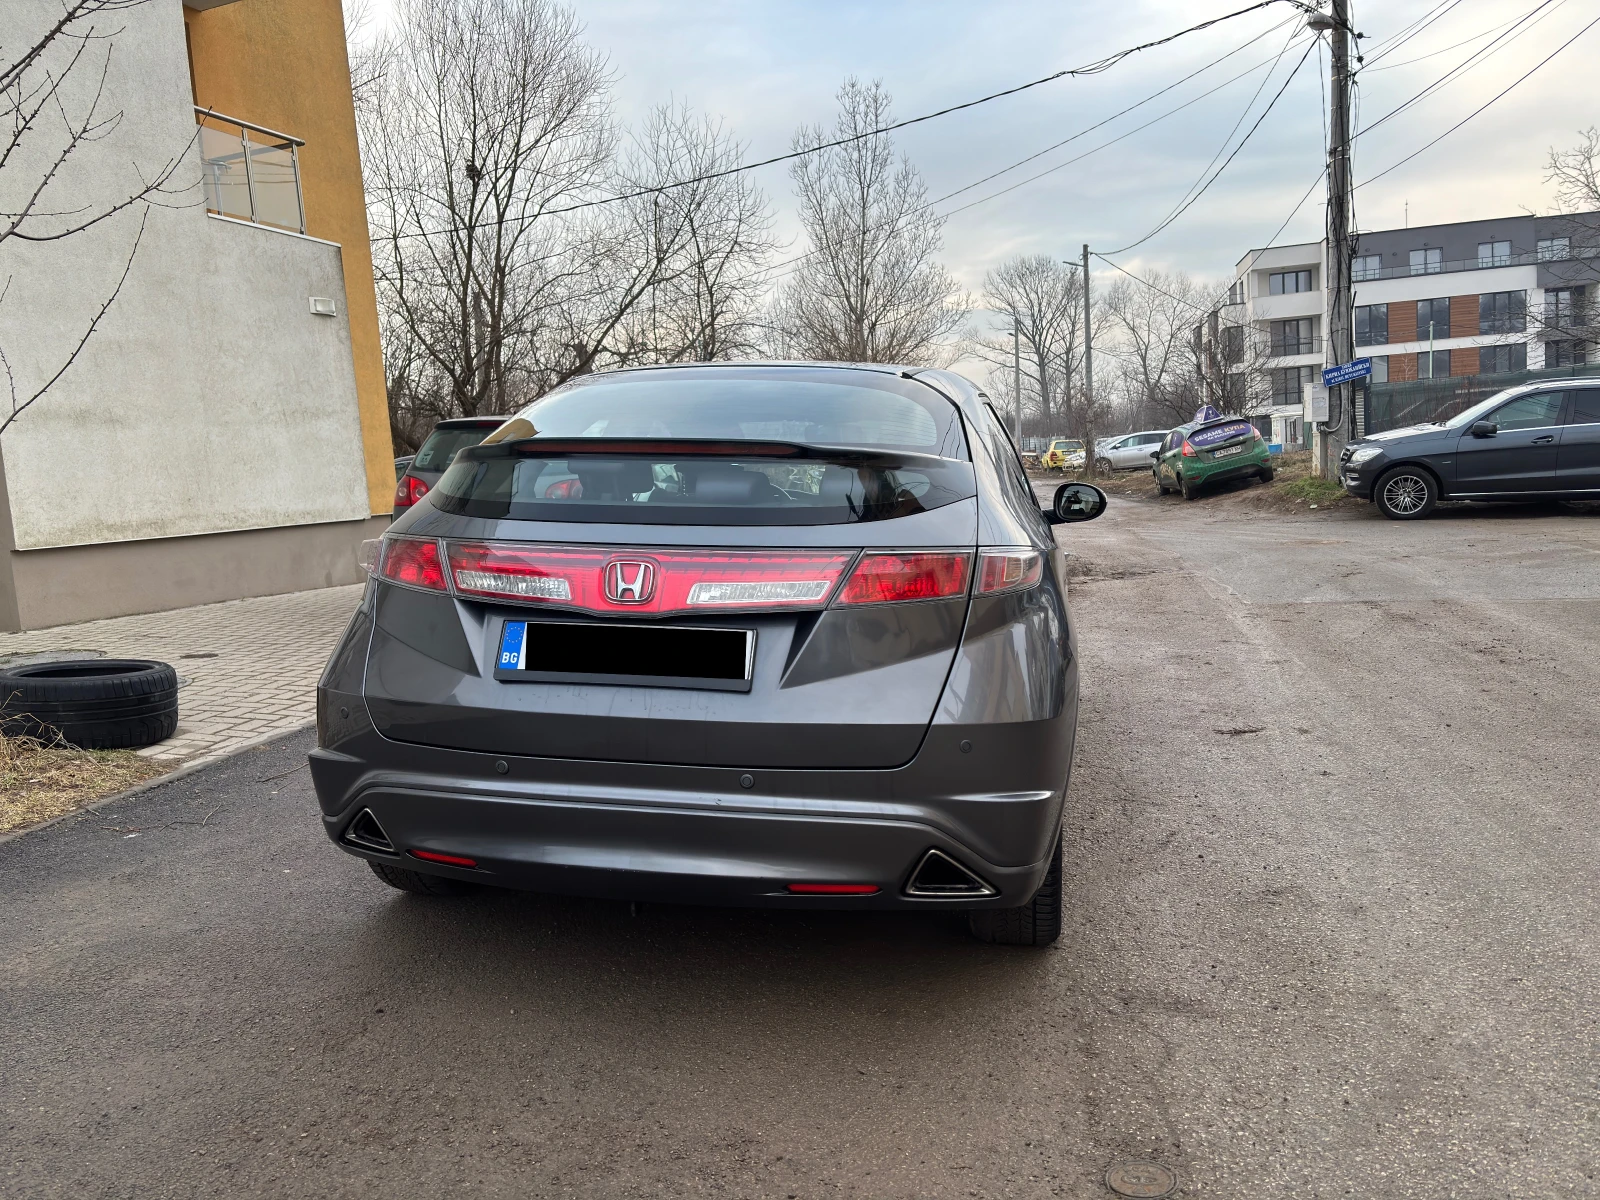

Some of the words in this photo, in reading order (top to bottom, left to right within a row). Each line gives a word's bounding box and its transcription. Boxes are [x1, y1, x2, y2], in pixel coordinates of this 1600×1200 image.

[1194, 429, 1223, 442] SESAME
[1223, 424, 1246, 433] КУПА
[501, 651, 518, 664] BG
